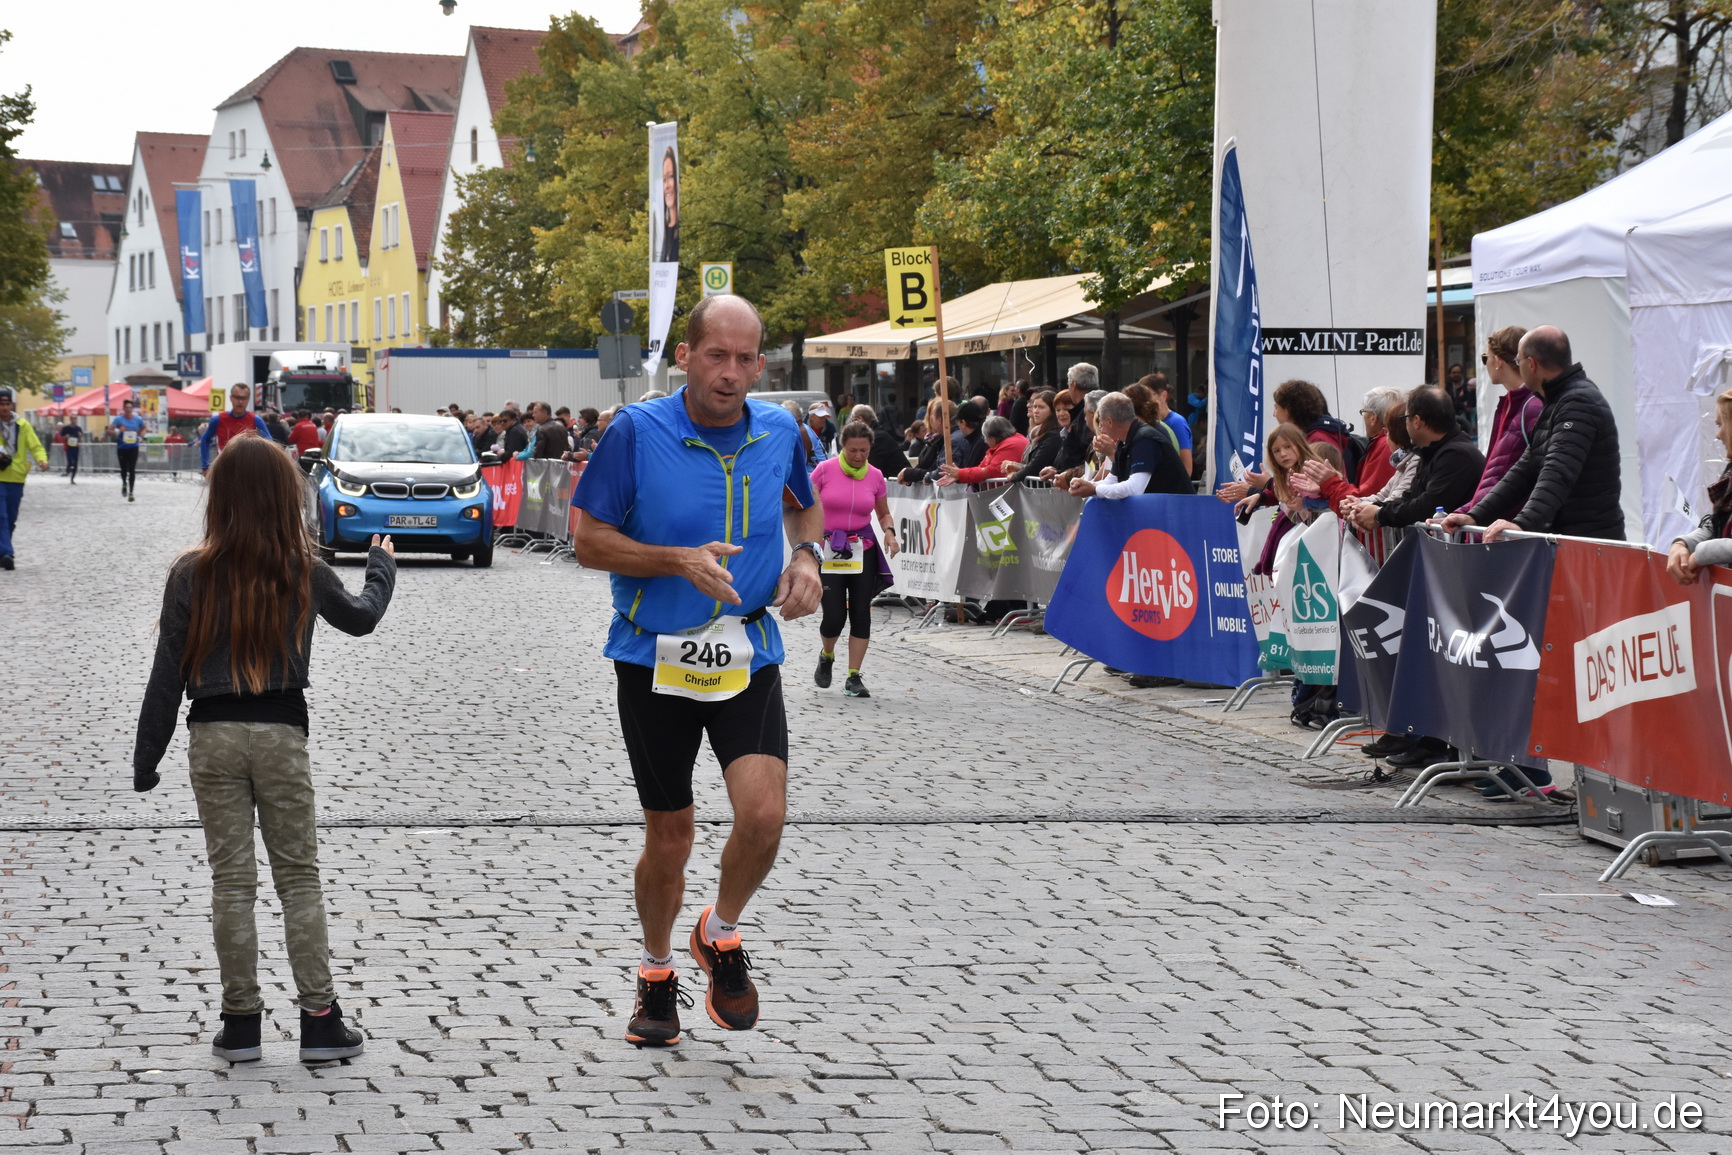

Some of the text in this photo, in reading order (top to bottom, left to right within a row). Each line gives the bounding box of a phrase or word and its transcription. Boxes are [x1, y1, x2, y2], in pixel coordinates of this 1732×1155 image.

[891, 250, 932, 266] Block
[901, 272, 928, 311] B
[212, 395, 222, 408] D
[390, 516, 406, 526] PAR
[425, 516, 436, 526] 4E
[1212, 547, 1239, 564] STORE
[1118, 550, 1194, 619] Hervis
[1214, 582, 1245, 599] ONLINE
[1131, 608, 1161, 625] SPORTS
[1217, 616, 1247, 634] MOBILE
[680, 640, 732, 668] 246
[1586, 624, 1686, 703] DAS NEUE
[684, 673, 722, 687] Christof
